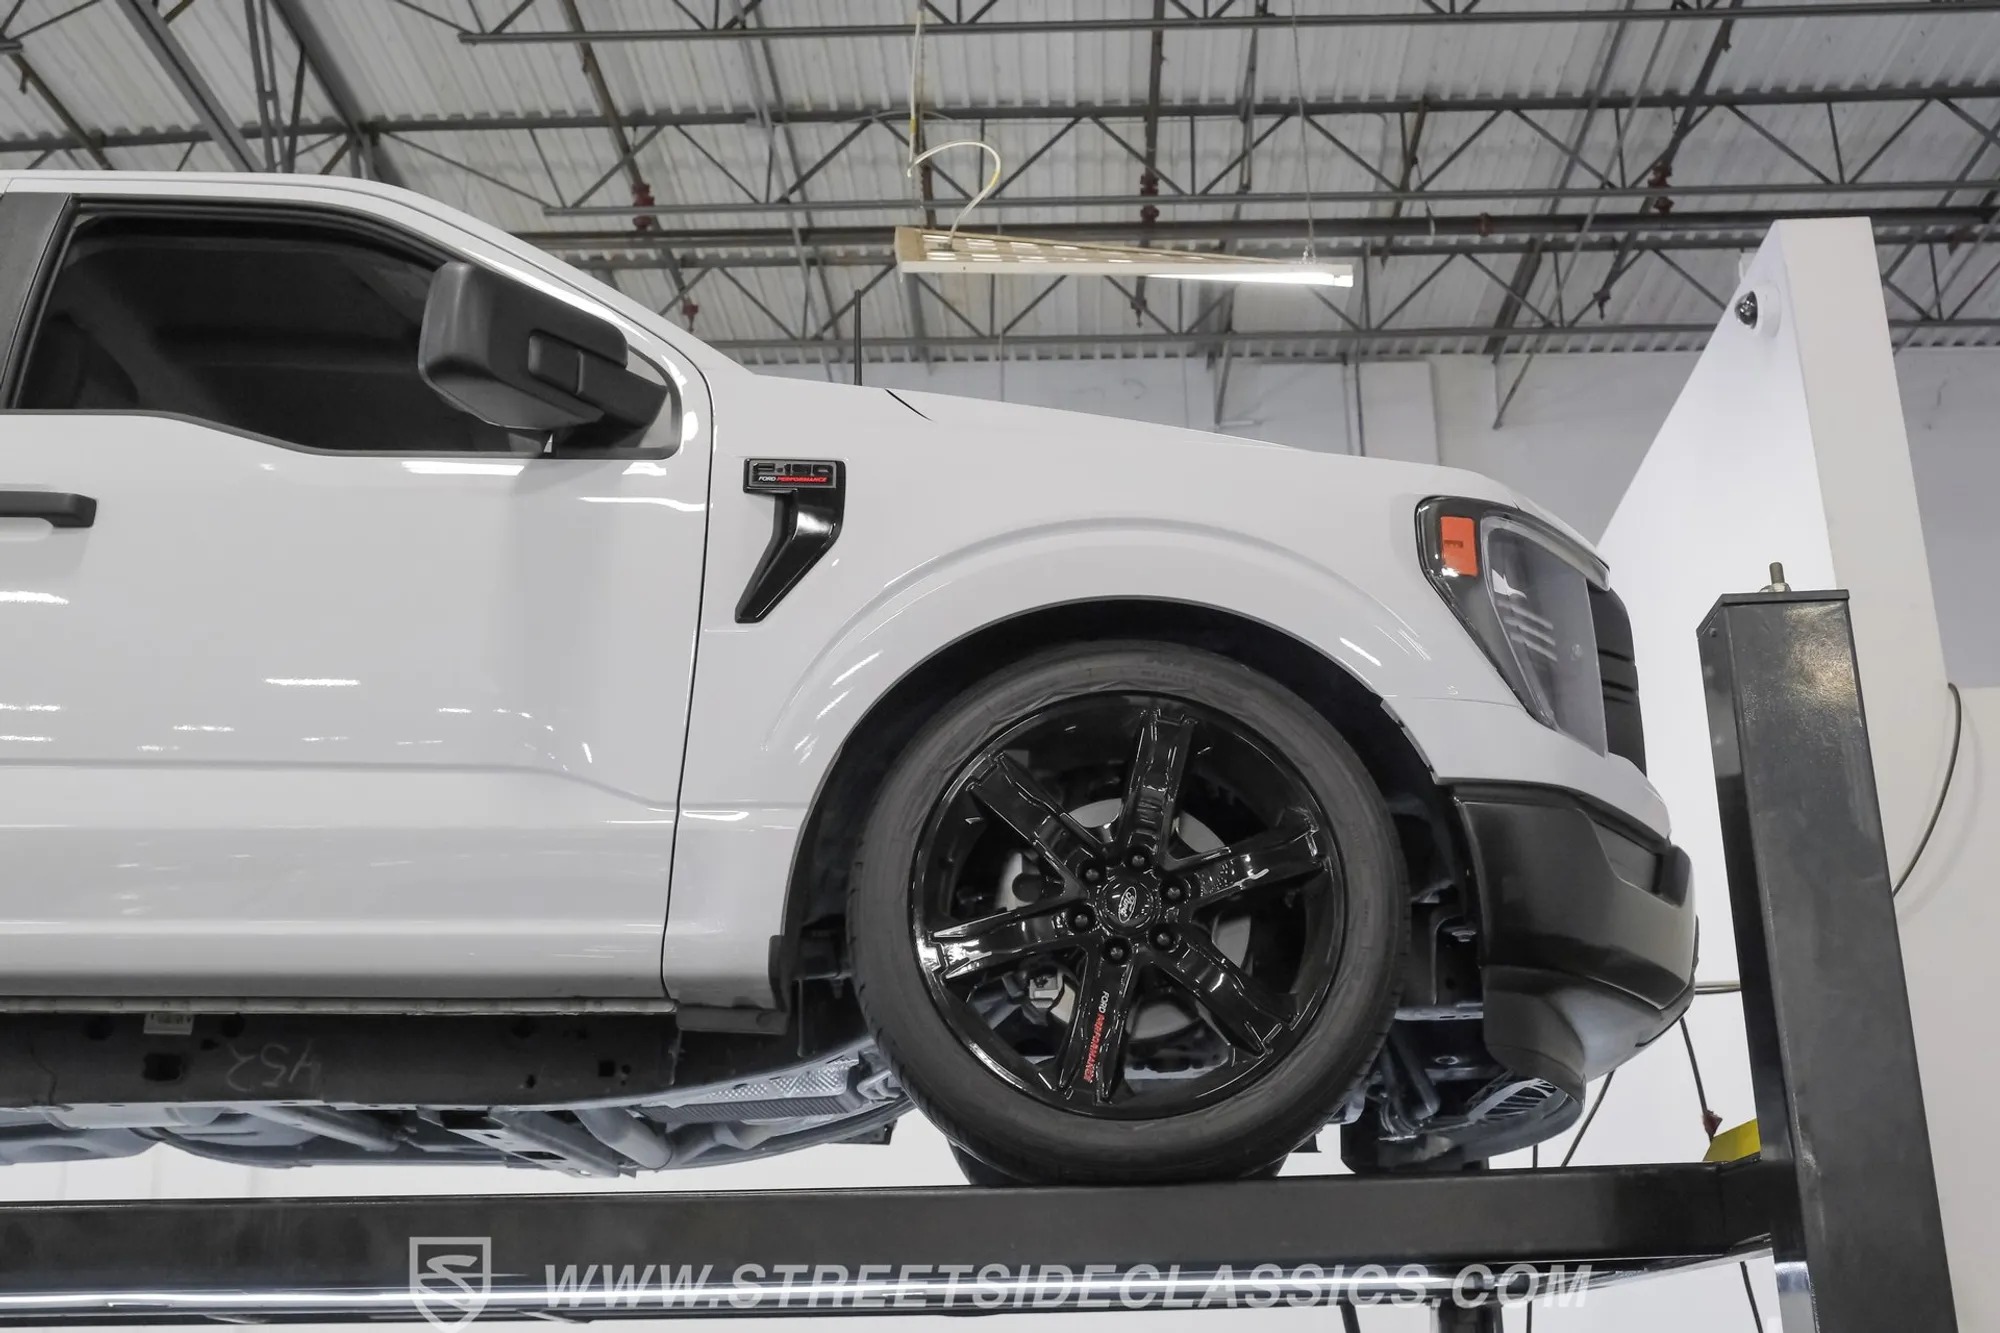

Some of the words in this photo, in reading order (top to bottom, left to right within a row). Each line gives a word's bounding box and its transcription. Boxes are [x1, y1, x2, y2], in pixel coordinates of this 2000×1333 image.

[776, 475, 828, 483] PERFORMANCE
[1099, 990, 1109, 1014] FORD
[1083, 1013, 1105, 1083] PERFORMANCE
